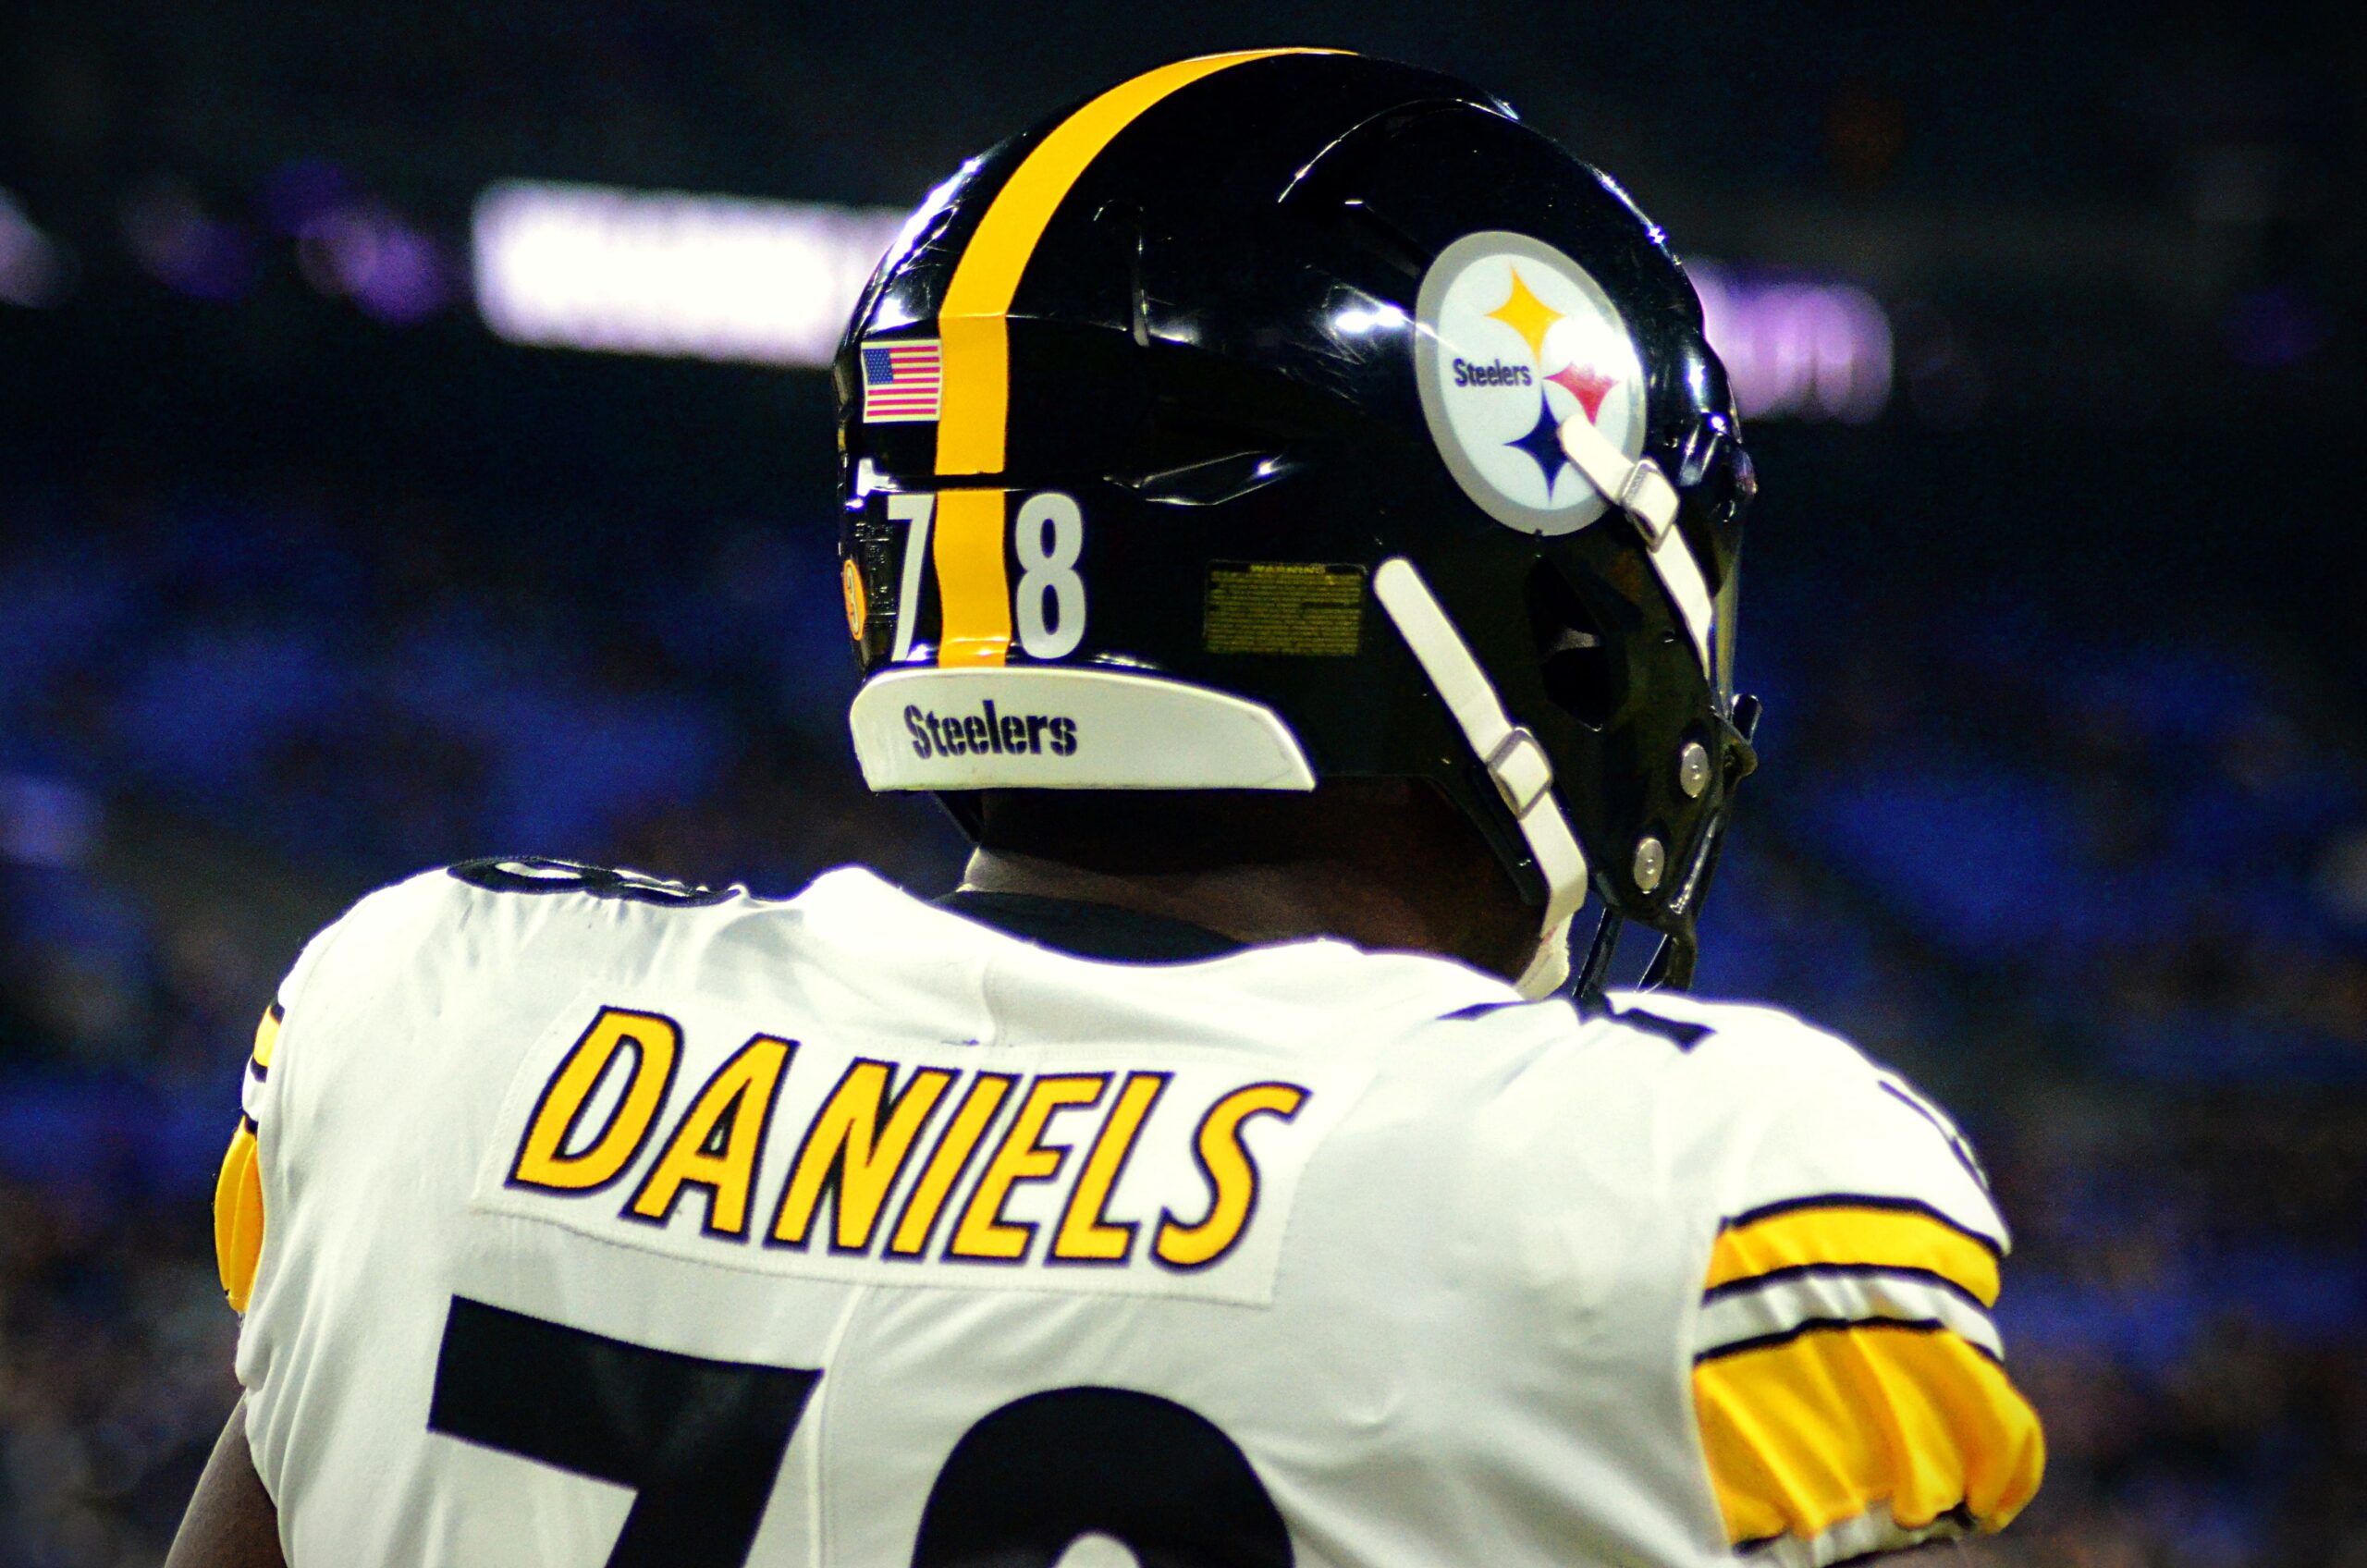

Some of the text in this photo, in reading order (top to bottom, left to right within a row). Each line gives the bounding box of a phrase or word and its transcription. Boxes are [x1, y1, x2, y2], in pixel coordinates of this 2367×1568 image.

[1453, 358, 1533, 387] Steelers
[903, 698, 1078, 760] Steelers
[505, 1005, 1313, 1274] DANIELS
